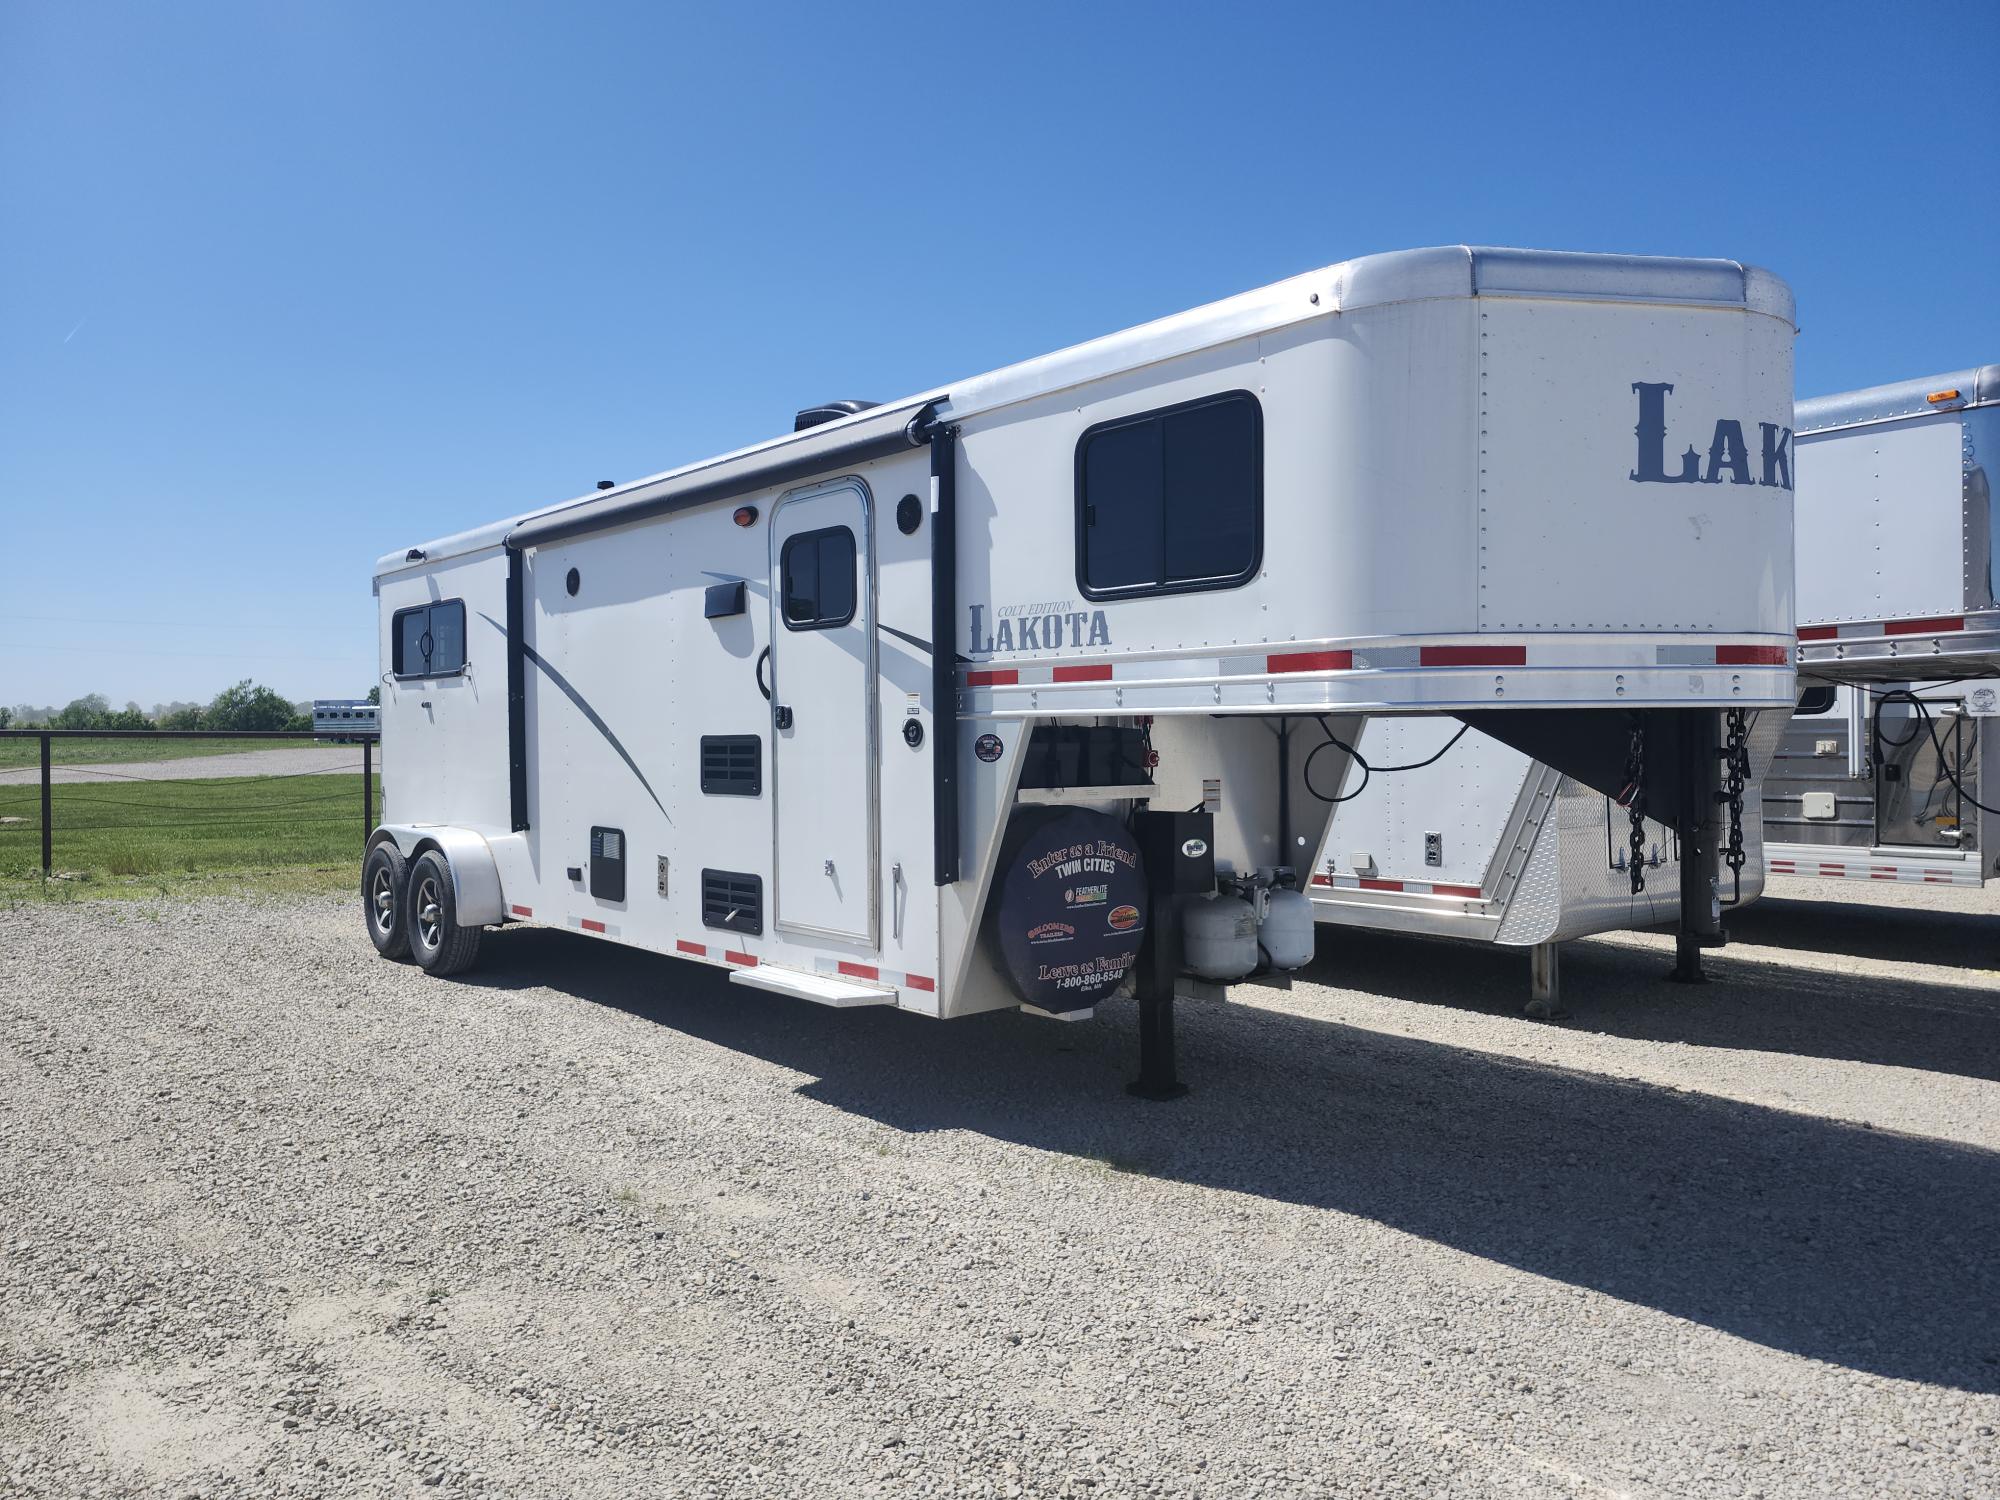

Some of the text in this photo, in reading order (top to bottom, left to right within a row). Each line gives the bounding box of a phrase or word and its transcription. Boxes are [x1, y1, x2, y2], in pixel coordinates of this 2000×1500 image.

[998, 600, 1075, 618] COLT EDITION
[969, 604, 1113, 653] LAKOTA
[1027, 840, 1137, 878] Enter as a Friend
[1055, 857, 1116, 879] TWIN CITIES
[1075, 884, 1108, 896] FEATHERLITE
[1038, 952, 1137, 980] Leave as Family
[1056, 969, 1124, 989] 1-800-860-6548
